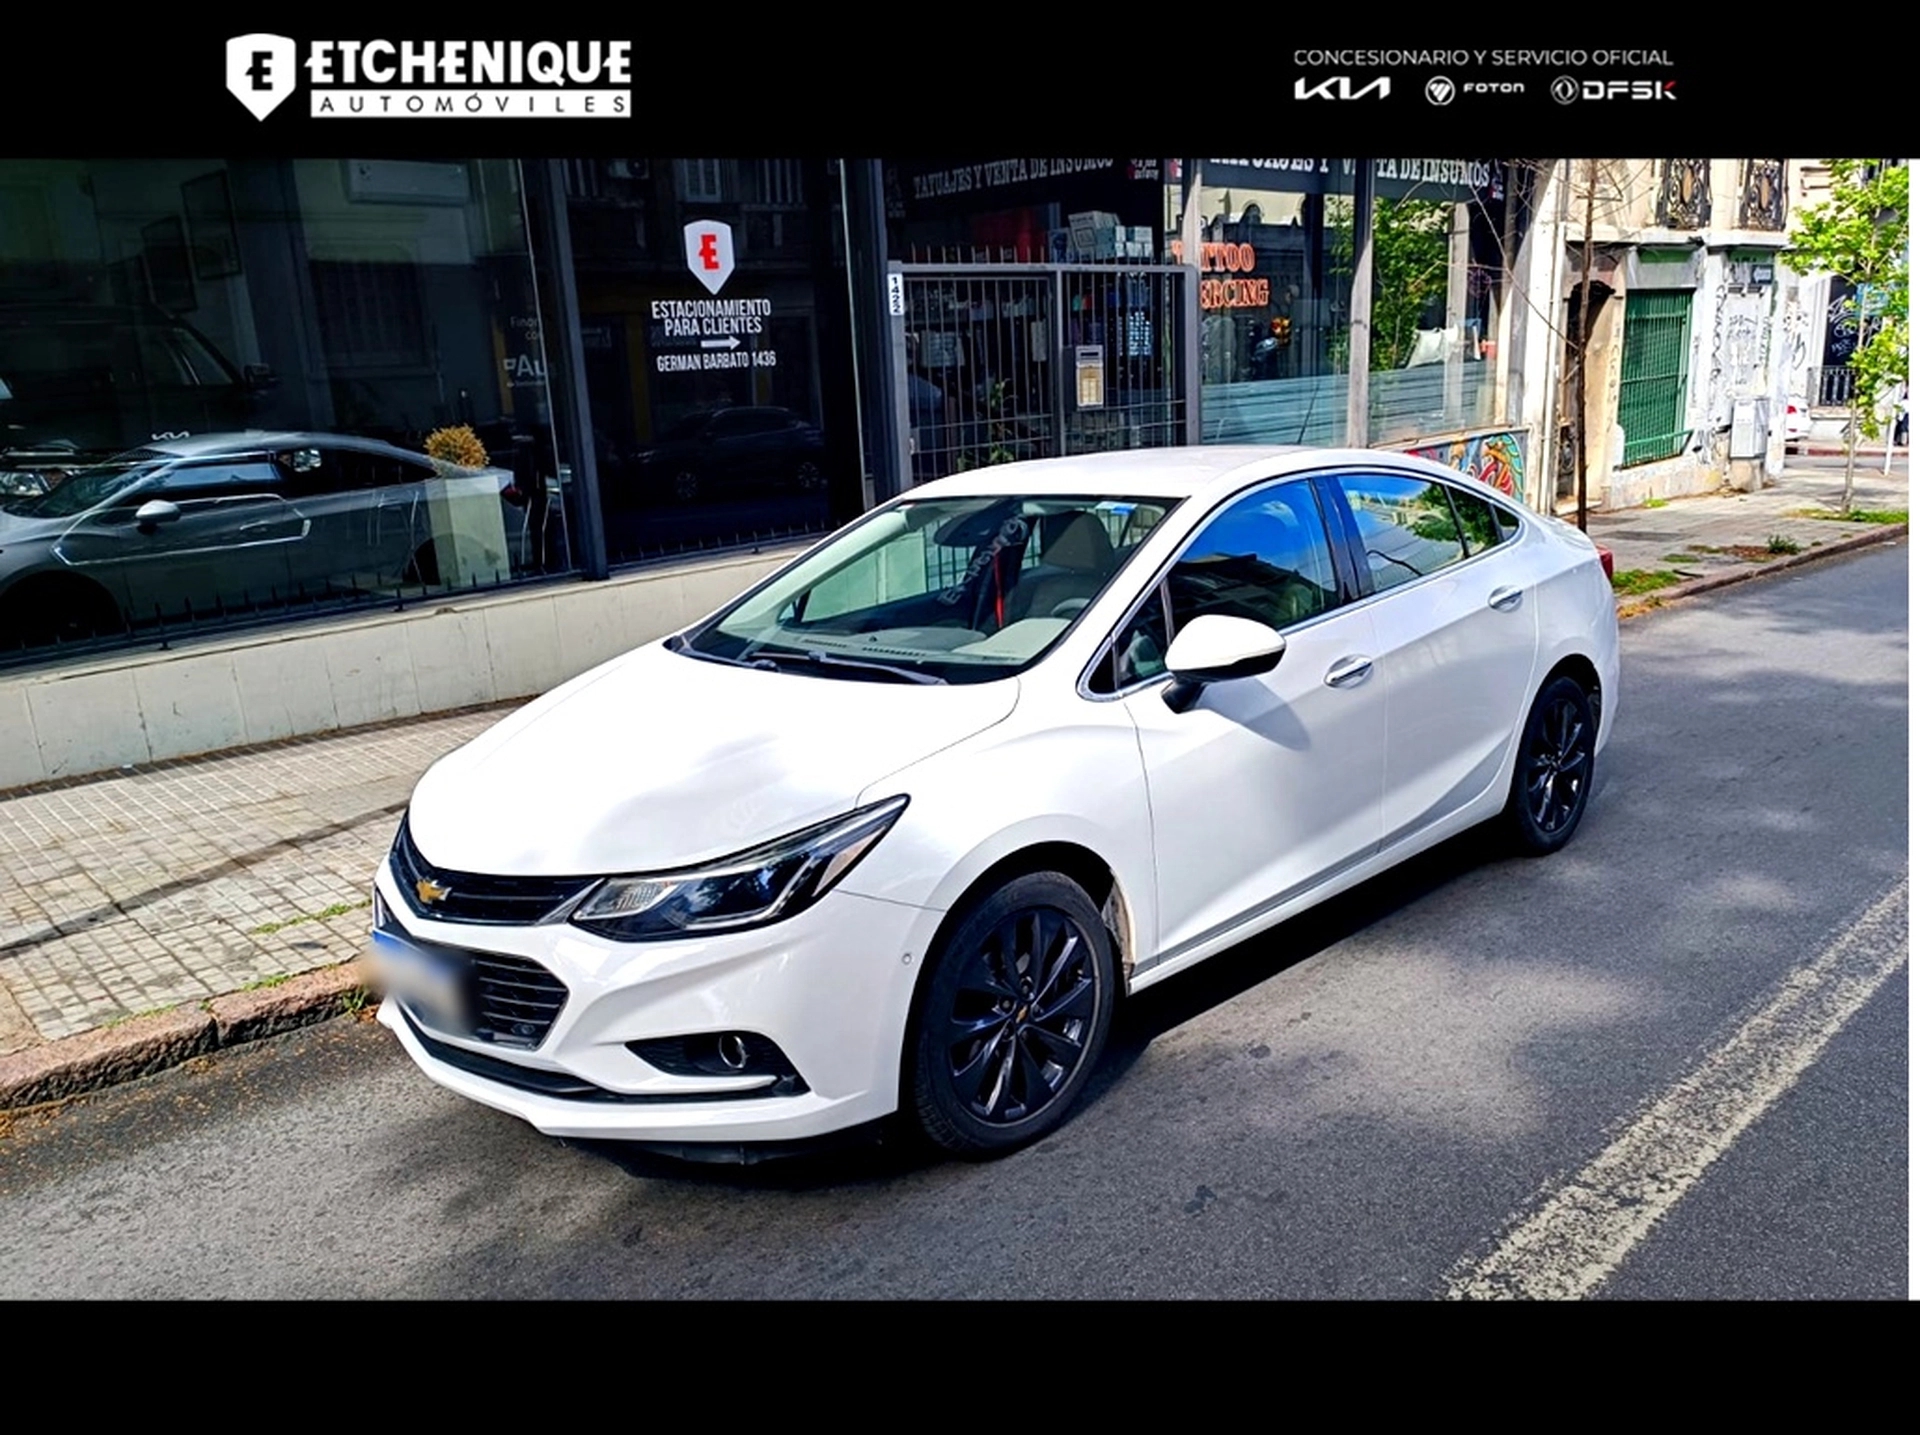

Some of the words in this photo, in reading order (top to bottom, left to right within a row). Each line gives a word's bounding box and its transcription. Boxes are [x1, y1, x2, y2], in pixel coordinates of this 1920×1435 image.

[973, 165, 983, 188] Y
[984, 159, 1028, 186] VENTA
[651, 299, 771, 319] ESTACIONAMIENTO
[665, 319, 700, 336] PARA
[702, 316, 762, 335] CLIENTES
[657, 354, 701, 372] GERMAN
[703, 351, 748, 369] BARBATO
[752, 350, 776, 366] 1436
